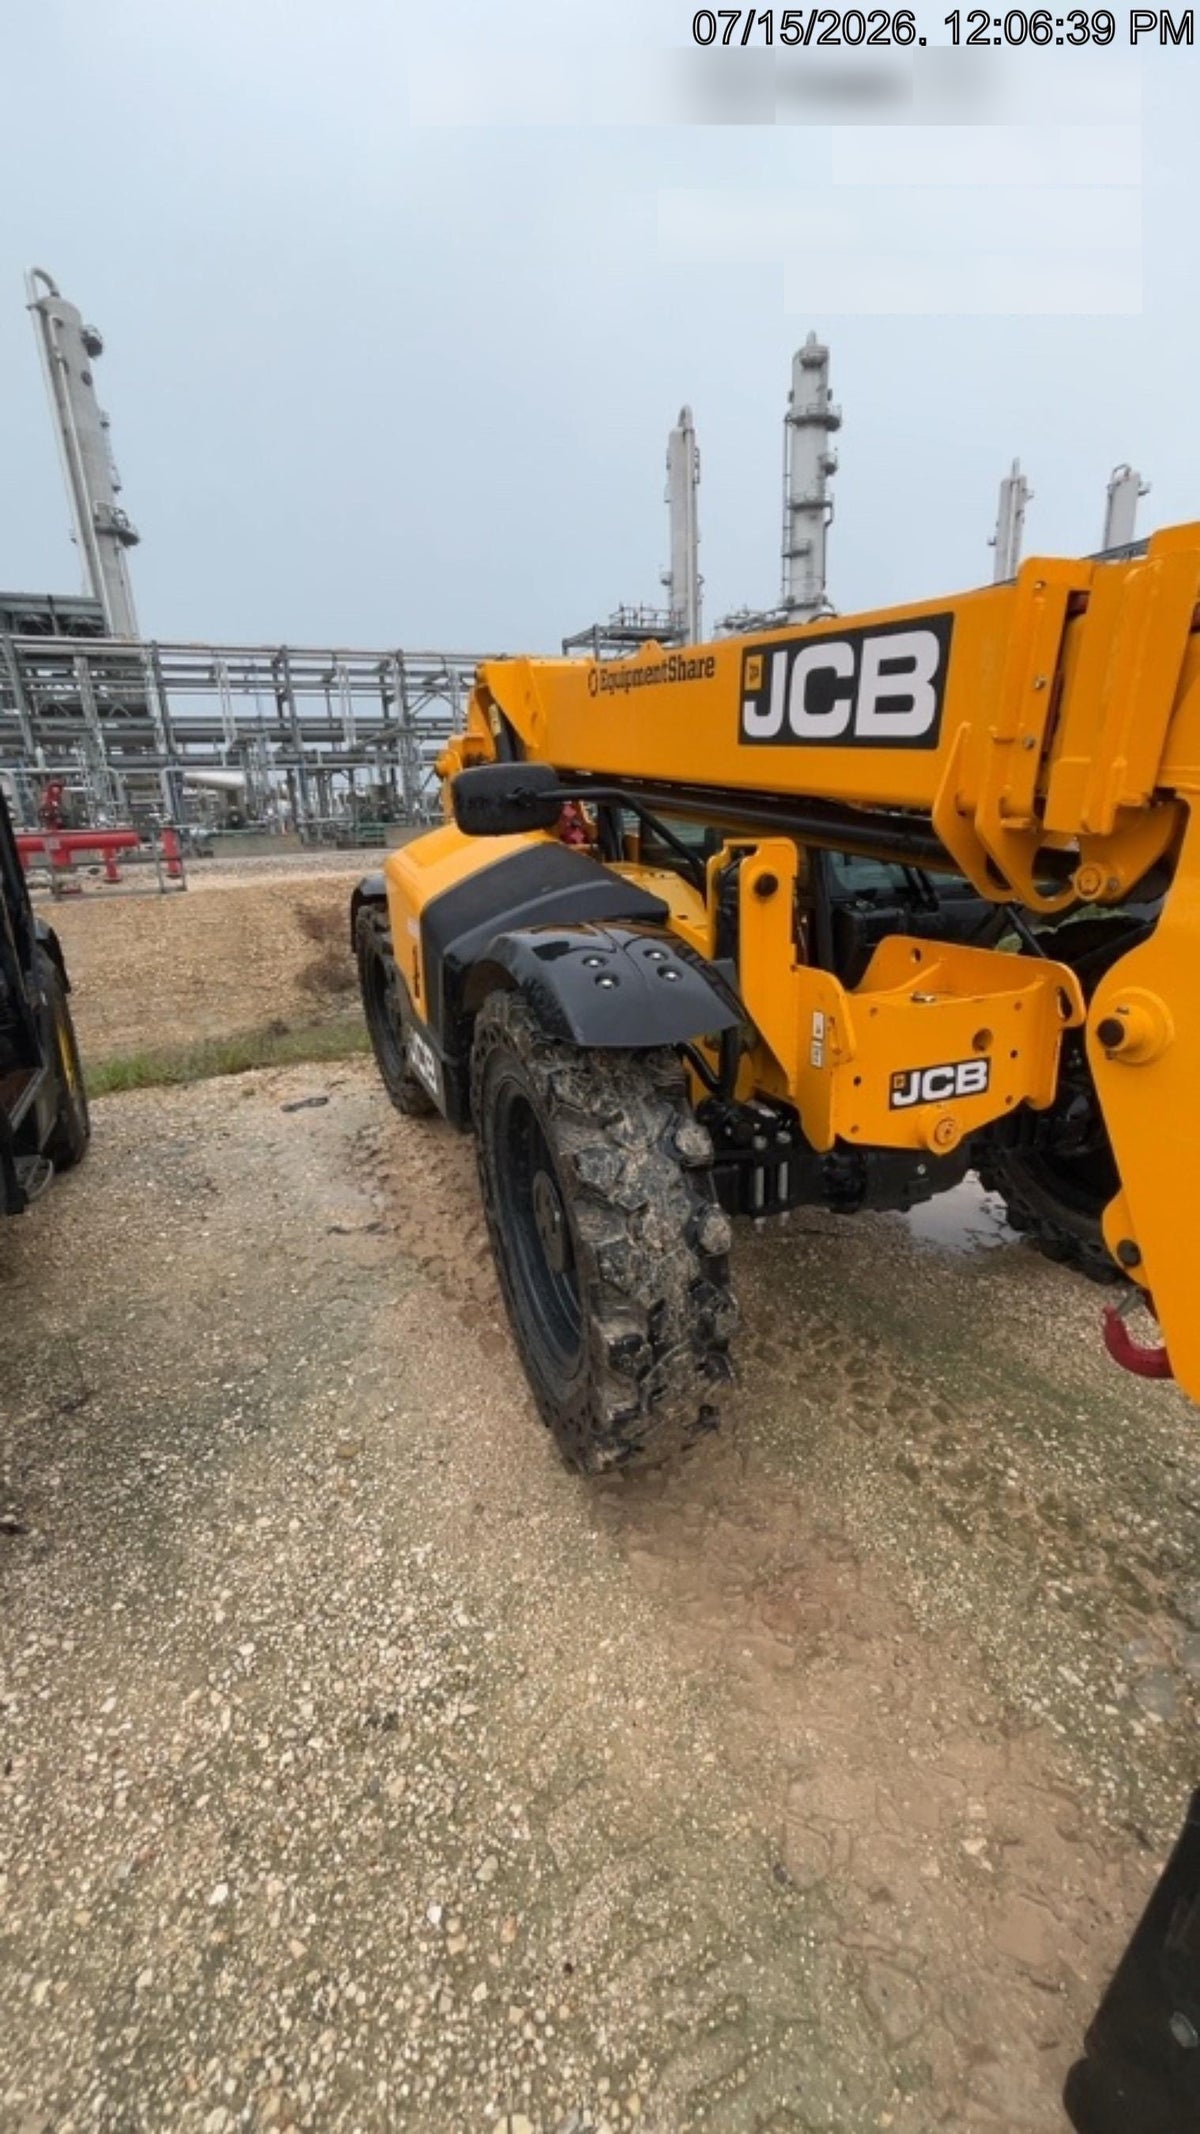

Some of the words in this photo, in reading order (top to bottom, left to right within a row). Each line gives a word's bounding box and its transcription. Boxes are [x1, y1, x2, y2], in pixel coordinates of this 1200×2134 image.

[599, 655, 715, 695] EquipmentShare
[742, 630, 939, 739] JCB
[891, 1060, 988, 1106] JCB
